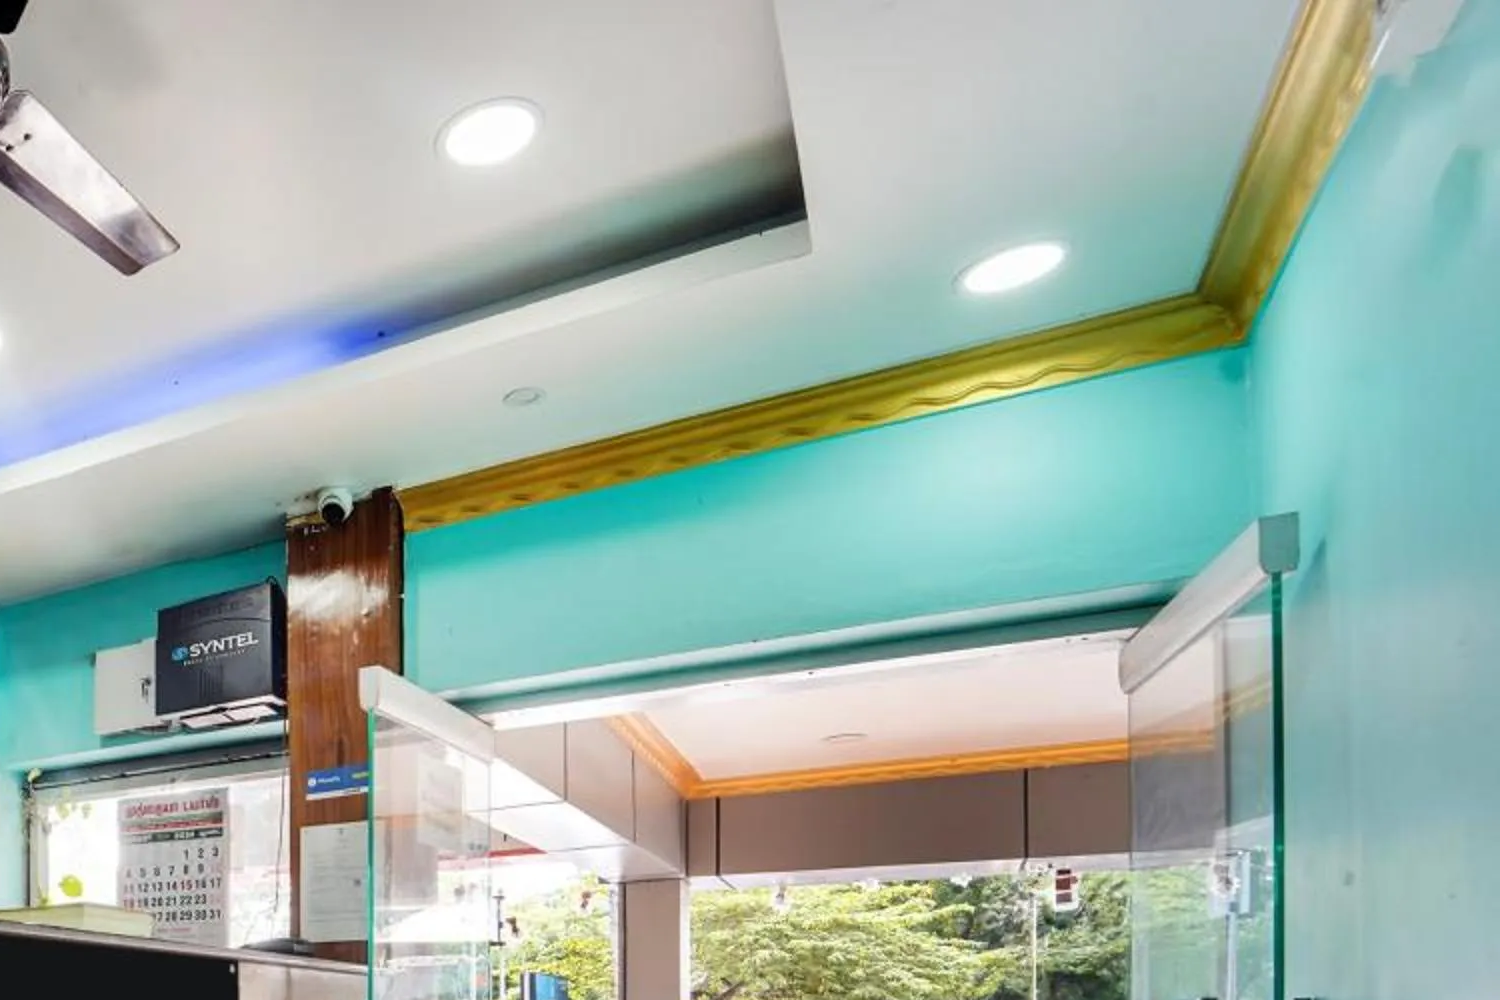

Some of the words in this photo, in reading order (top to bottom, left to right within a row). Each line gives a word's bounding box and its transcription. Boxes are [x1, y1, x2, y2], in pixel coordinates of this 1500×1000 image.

[189, 631, 259, 657] SYNTEL
[183, 848, 189, 860] 1
[198, 847, 204, 859] 2
[211, 845, 219, 857] 3
[168, 865, 175, 876] 7
[166, 880, 177, 891] 14
[180, 879, 193, 891] 15
[210, 877, 221, 888] 17
[165, 895, 177, 906] 21
[180, 894, 193, 905] 22
[194, 893, 207, 905] 23
[209, 908, 221, 919] 31
